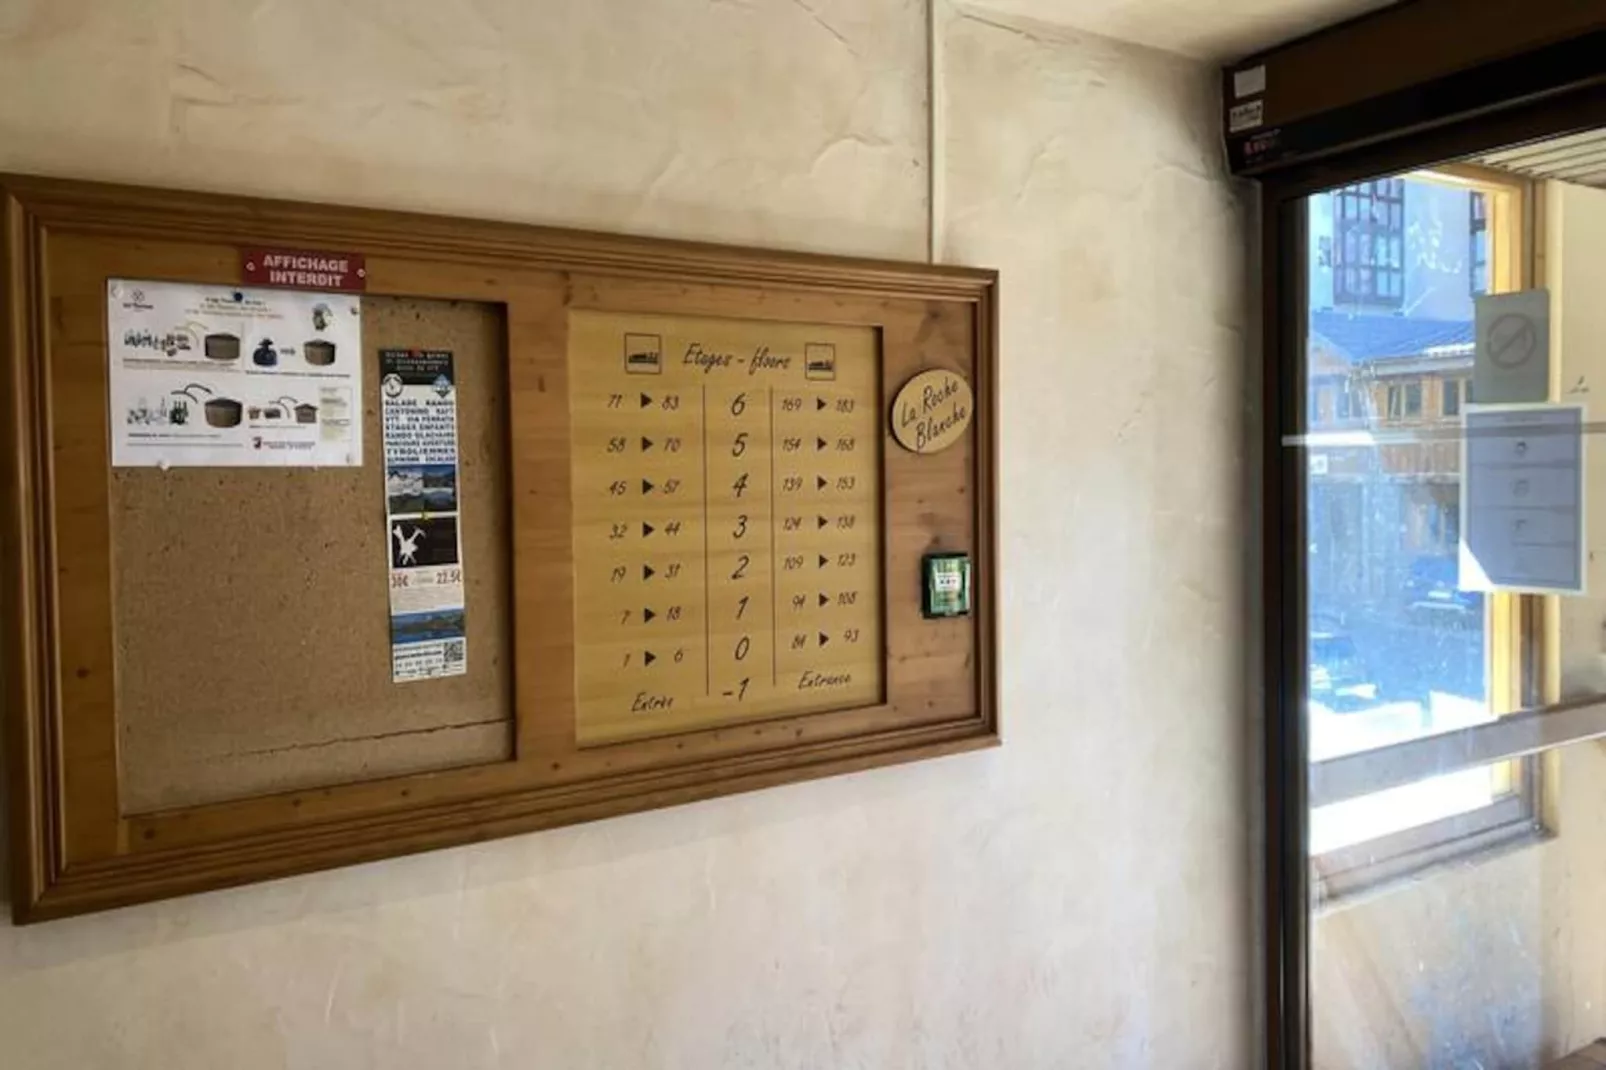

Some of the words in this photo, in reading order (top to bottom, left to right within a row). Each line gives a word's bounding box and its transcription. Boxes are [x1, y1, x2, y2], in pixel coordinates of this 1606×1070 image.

[263, 254, 348, 273] AFFICHAGE
[270, 270, 343, 287] INTERDIT
[748, 346, 791, 376] floors
[731, 393, 746, 416] 6
[782, 399, 802, 411] 169
[901, 401, 917, 429] La
[922, 376, 959, 415] Roche
[915, 401, 966, 454] Blanche
[607, 437, 626, 452] 58
[664, 437, 681, 452] 70
[732, 433, 748, 458] 5
[782, 440, 802, 452] 154
[609, 481, 627, 495] 45
[732, 473, 748, 498] 4
[782, 478, 803, 491] 139
[836, 476, 856, 490] 153
[609, 523, 628, 540] 32
[665, 521, 681, 535] 44
[733, 514, 748, 538] 3
[783, 517, 803, 531] 124
[731, 555, 750, 580] 2
[784, 556, 804, 570] 109
[837, 554, 857, 567] 123
[736, 596, 750, 620] 1
[792, 595, 807, 611] 94
[843, 631, 860, 642] 93
[735, 636, 750, 661] 0
[722, 677, 750, 703] -1
[797, 671, 853, 690] Entrance
